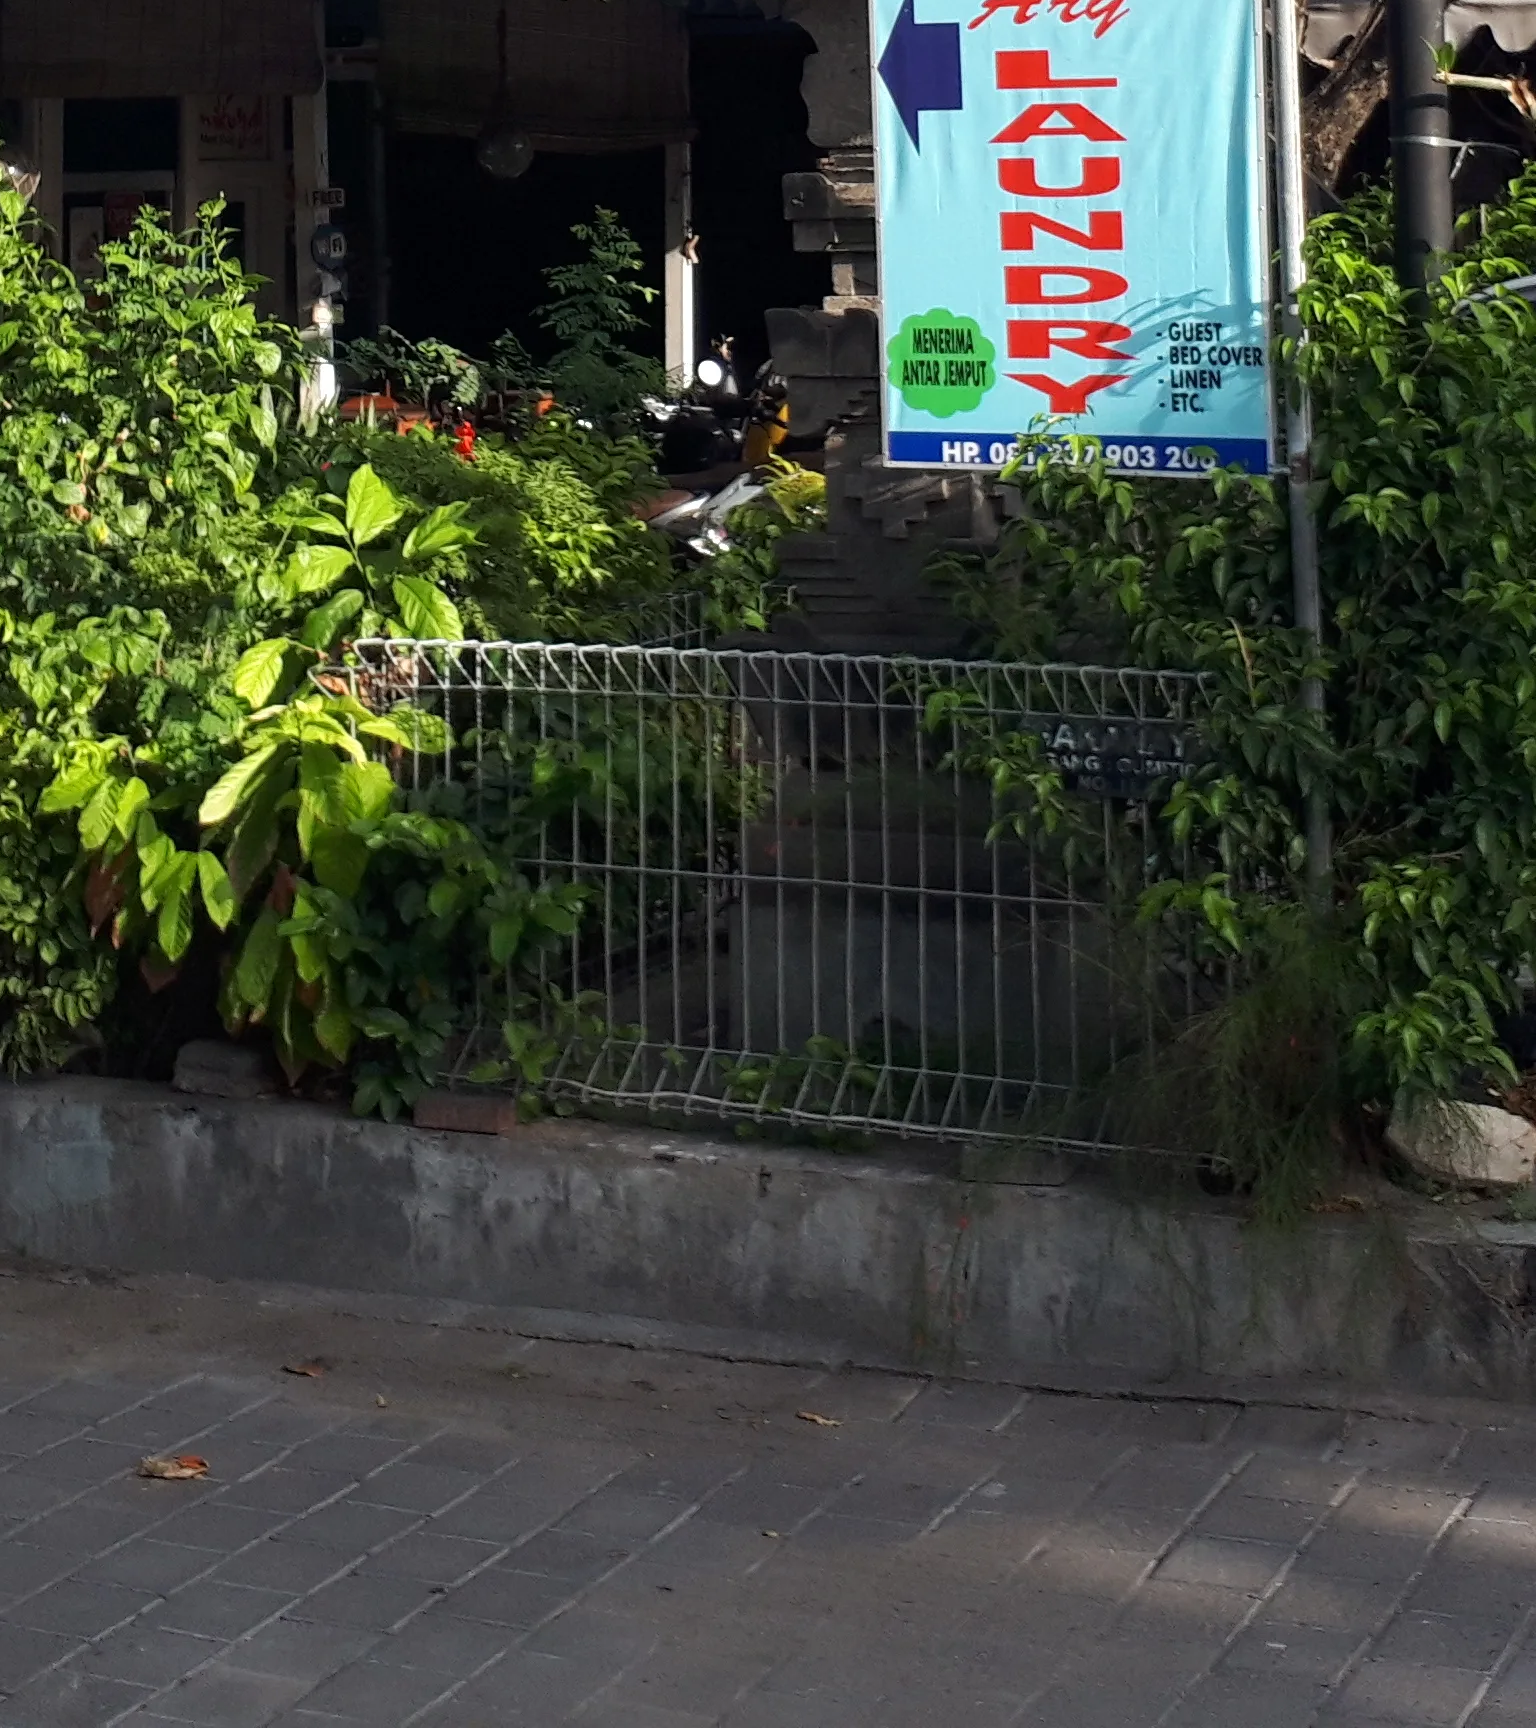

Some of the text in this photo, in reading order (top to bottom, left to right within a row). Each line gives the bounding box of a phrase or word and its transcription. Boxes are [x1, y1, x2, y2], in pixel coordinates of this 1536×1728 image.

[989, 50, 1139, 414] LAUNDRY
[912, 327, 974, 355] MENERIMA
[1168, 321, 1222, 342] GUEST
[1169, 345, 1264, 367] BED COVER
[902, 359, 987, 387] ANTAR JEMPUT
[1170, 369, 1222, 390] LINEN
[1171, 392, 1205, 413] ETC.
[941, 440, 980, 465] HP.
[1105, 444, 1156, 468] 903
